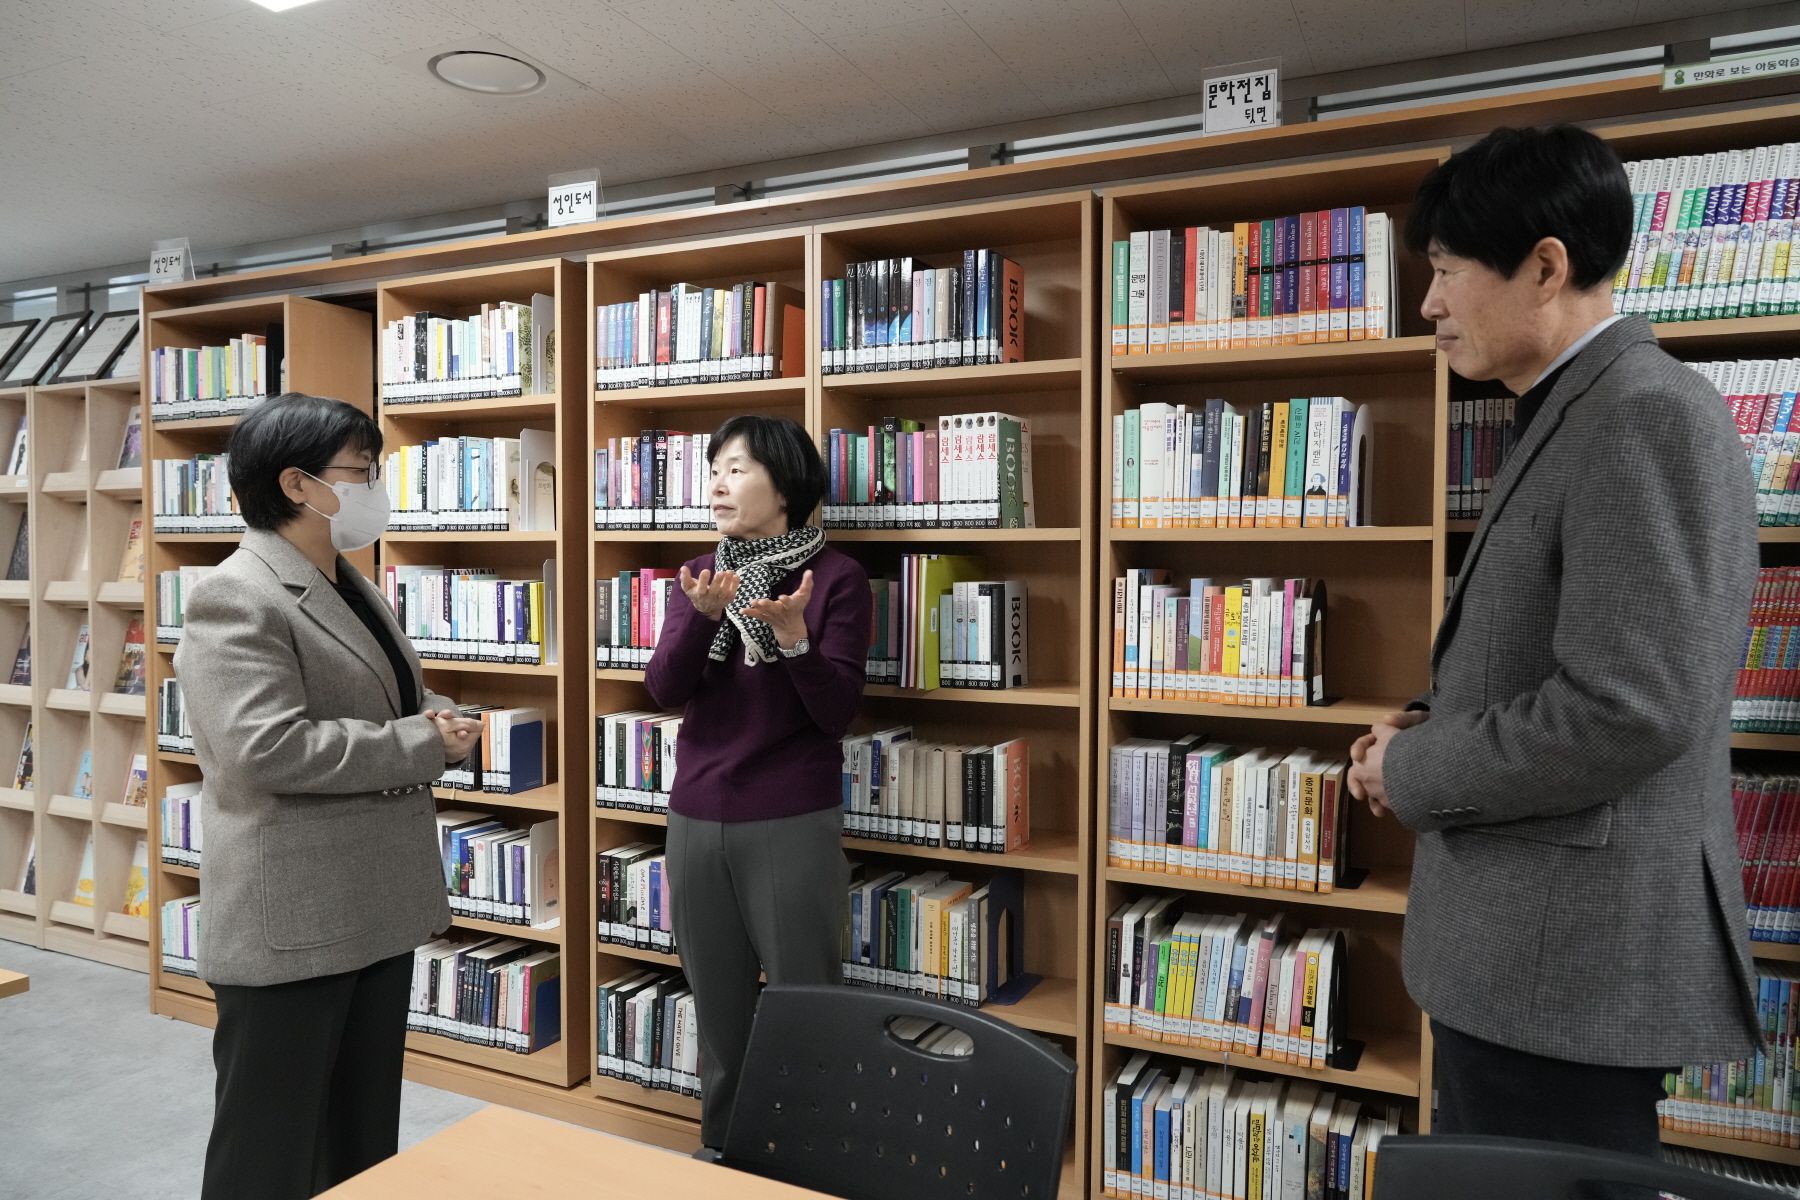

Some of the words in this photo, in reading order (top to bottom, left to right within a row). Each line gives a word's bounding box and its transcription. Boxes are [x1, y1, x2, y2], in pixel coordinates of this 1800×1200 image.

[1694, 69, 1725, 81] 만화로
[1730, 66, 1750, 76] 보는
[1208, 76, 1271, 109] 문학전집
[1245, 106, 1267, 124] 뒷면
[553, 191, 591, 215] 성인도서
[1641, 198, 1657, 232] Why?
[1652, 195, 1668, 229] Why?
[1679, 193, 1695, 229] Why?
[1691, 192, 1707, 227] Why?
[1704, 190, 1720, 224] Why?
[1718, 188, 1734, 222] Why?
[1730, 187, 1747, 222] Why?
[1743, 185, 1760, 220] Why?
[1758, 184, 1773, 220] Why?
[1772, 182, 1788, 218] Why?
[1784, 182, 1799, 217] Why?
[154, 255, 180, 273] 성인도서
[1009, 278, 1018, 347] BOOK
[1131, 345, 1145, 353] 900
[1334, 331, 1344, 339] 900
[1294, 408, 1302, 428] 신들의
[1738, 399, 1754, 431] Why?
[1751, 399, 1767, 431] Why?
[1764, 398, 1781, 431] Why?
[1778, 395, 1793, 430] Why?
[941, 437, 949, 464] 람세스
[954, 434, 962, 461] 람세스
[965, 436, 973, 462] 람세스
[977, 434, 985, 460] 람세스
[988, 433, 996, 459] 람세스
[1294, 431, 1301, 445] 시간
[1312, 421, 1322, 464] 판타지랜드
[1244, 602, 1251, 613] 세계
[1011, 596, 1021, 664] BOOK
[1013, 757, 1022, 825] BOOK
[1268, 984, 1277, 1006] Italian
[1267, 1008, 1276, 1019] Joy
